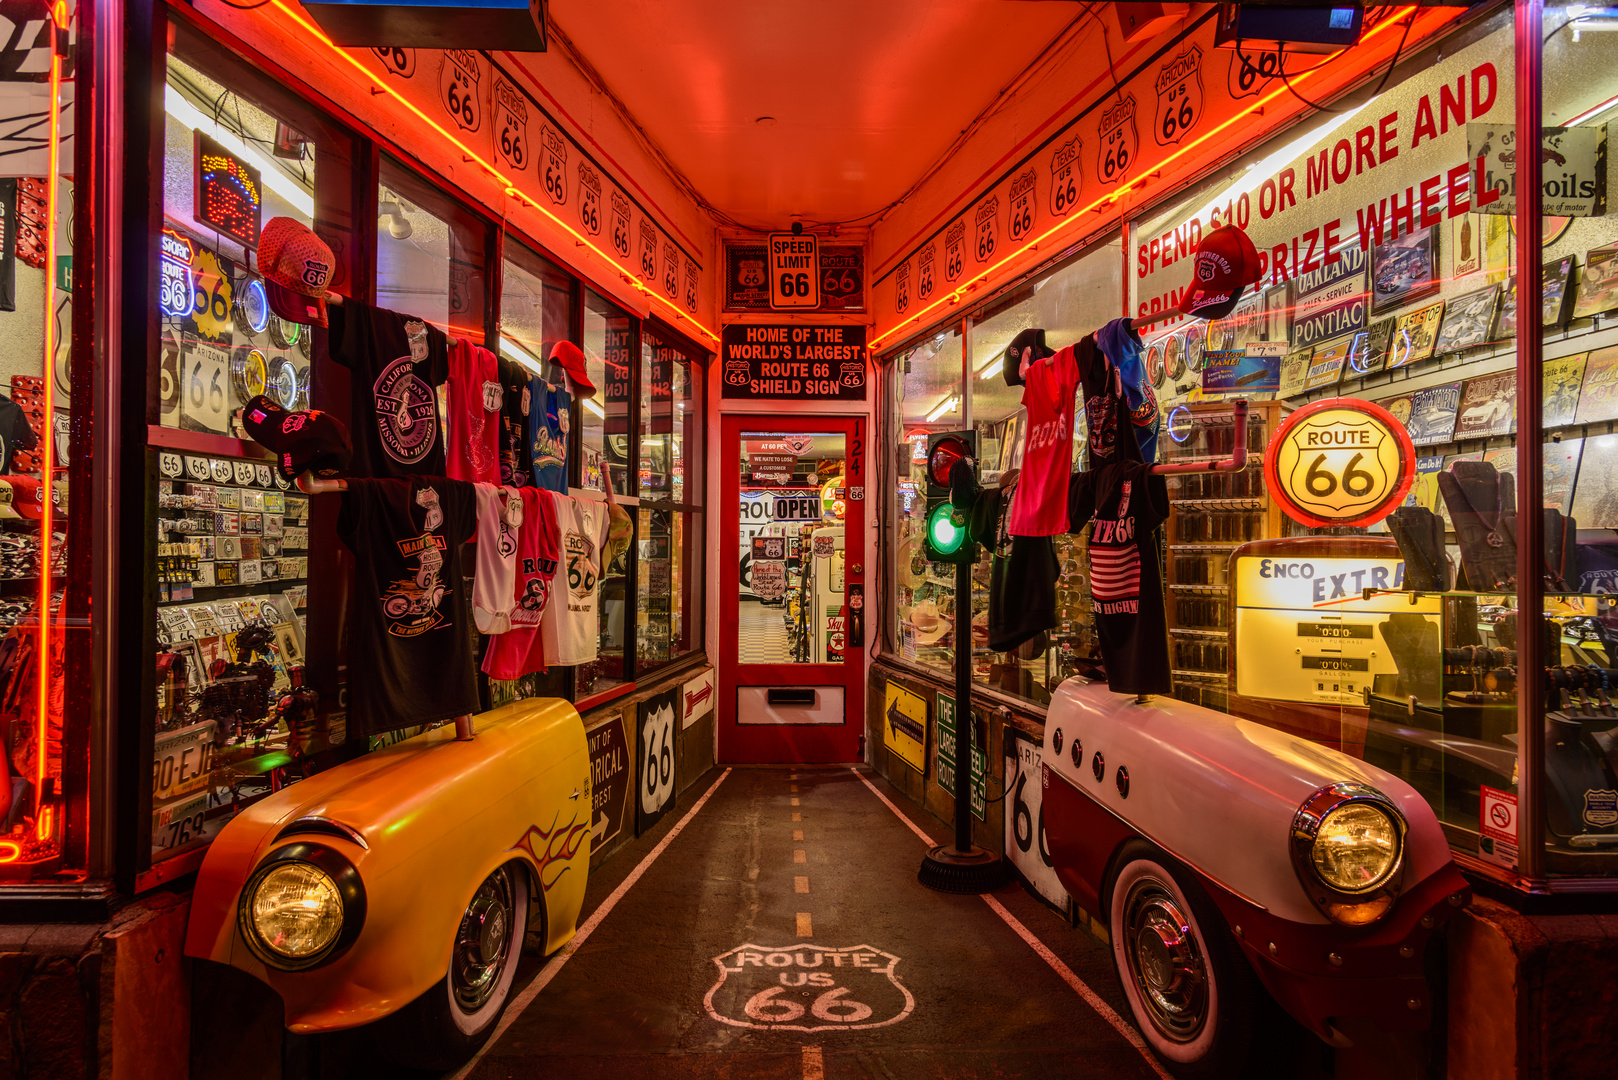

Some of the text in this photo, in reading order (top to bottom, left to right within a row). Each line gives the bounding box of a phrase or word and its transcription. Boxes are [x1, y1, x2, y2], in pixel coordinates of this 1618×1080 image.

[454, 68, 469, 88] US
[1160, 54, 1196, 90] ARIZONA
[1169, 84, 1185, 102] US
[448, 83, 474, 126] 66
[506, 114, 519, 131] US
[1162, 96, 1193, 139] 66
[1109, 128, 1122, 145] US
[501, 127, 523, 165] 66
[547, 134, 563, 158] TEXAS
[550, 155, 560, 170] US
[1057, 145, 1076, 167] TEXAS
[1104, 140, 1128, 178] 66
[1060, 167, 1071, 181] US
[1138, 62, 1498, 278] SPEND $10 OR MORE AND
[546, 167, 562, 200] 66
[586, 191, 595, 203] US
[1017, 196, 1027, 209] US
[1056, 178, 1076, 211] 66
[582, 202, 597, 231] 66
[978, 201, 995, 221] KANSAS
[981, 221, 991, 233] US
[1013, 207, 1031, 237] 66
[1255, 218, 1342, 293] PRIZE
[1357, 154, 1500, 252] WHEEL
[162, 236, 190, 260] STORIC
[615, 227, 628, 253] 66
[774, 241, 813, 254] SPEED
[979, 231, 994, 258] 66
[642, 252, 654, 277] 66
[777, 256, 812, 268] LIMIT
[822, 257, 855, 266] ROUTE
[949, 253, 961, 278] 66
[1218, 257, 1232, 275] ROAD
[1299, 245, 1363, 293] OAKLAND
[307, 271, 325, 284] 66
[744, 274, 759, 284] 66
[823, 270, 856, 292] 66
[1200, 268, 1211, 278] 66
[161, 273, 186, 310] 66
[666, 273, 676, 295] 66
[780, 273, 809, 297] 66
[920, 274, 932, 296] 66
[1326, 283, 1353, 301] SERVICE
[194, 267, 228, 323] 66
[687, 289, 696, 309] 66
[898, 290, 908, 310] 66
[1294, 302, 1363, 346] PONTIAC
[1399, 311, 1420, 332] LAST
[1420, 305, 1441, 325] STOP
[747, 328, 843, 342] HOME OF THE
[197, 347, 225, 364] ARIZONA
[729, 345, 860, 359] WORLD'S LARGEST
[761, 362, 830, 377] ROUTE 66
[1209, 358, 1240, 366] NAME!
[1310, 364, 1325, 378] PARTS
[729, 374, 746, 383] 66
[844, 375, 860, 385] 66
[1309, 372, 1335, 387] Motorcraft
[1543, 364, 1568, 379] oute 66
[190, 361, 223, 414] 66
[750, 380, 840, 394] SHIELD SIGN
[377, 399, 398, 413] EST.
[1307, 430, 1370, 445] ROUTE
[1412, 436, 1431, 446] ERICAN
[1431, 435, 1451, 443] MUSCLE
[164, 456, 178, 472] 66
[193, 459, 206, 475] 66
[215, 463, 229, 478] 66
[238, 465, 252, 480] 66
[1417, 460, 1428, 469] Can
[1427, 459, 1435, 468] Do
[259, 469, 269, 482] 66
[1305, 452, 1374, 497] 66
[851, 491, 863, 499] 66
[740, 502, 773, 518] ROU
[777, 500, 819, 518] OPEN
[402, 539, 424, 554] MAIN
[523, 558, 557, 575] ROU
[567, 556, 596, 591] 66
[195, 612, 210, 620] ROUTE
[827, 617, 841, 631] Sky
[939, 699, 952, 724] THE
[154, 733, 201, 753] ARIZON
[589, 729, 612, 754] INT OF
[647, 721, 671, 796] 66
[1020, 746, 1042, 769] ARIZ
[590, 747, 622, 789] ORICAL
[939, 760, 983, 812] ROUTE IELD
[160, 809, 173, 828] DEC
[736, 952, 879, 967] ROUTE
[779, 972, 835, 987] US
[744, 986, 873, 1022] 66
